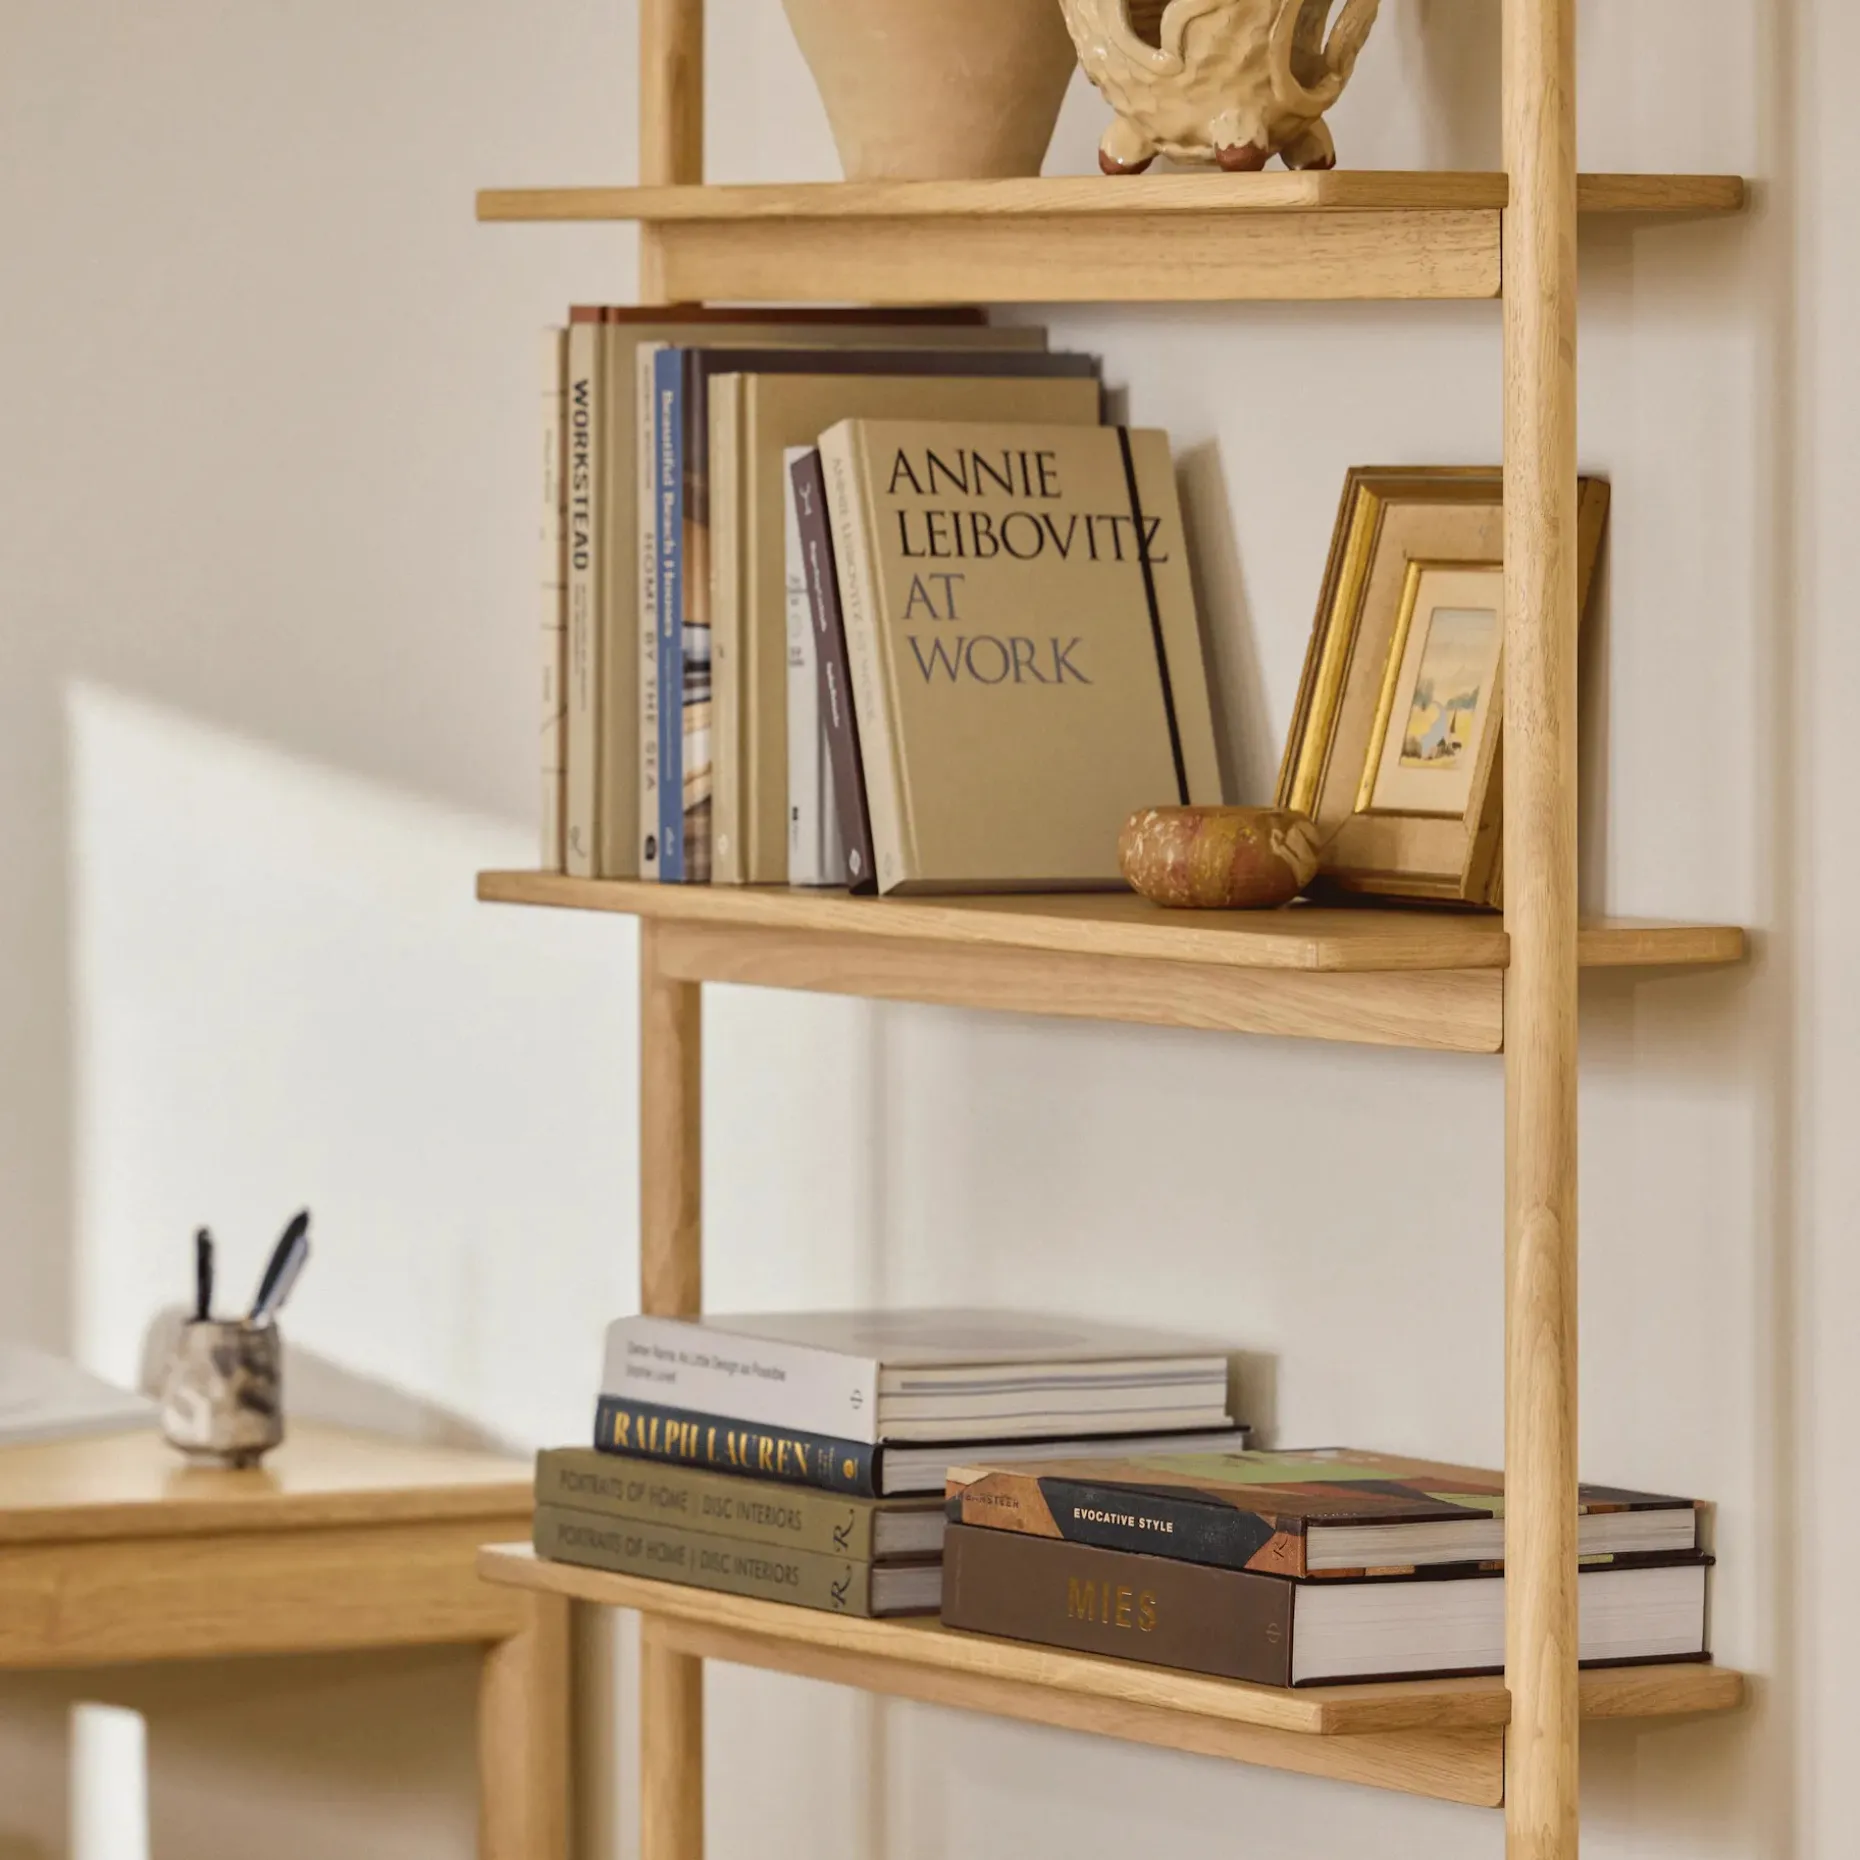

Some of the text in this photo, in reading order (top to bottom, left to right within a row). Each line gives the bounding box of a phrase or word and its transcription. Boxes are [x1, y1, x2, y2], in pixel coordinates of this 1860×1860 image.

[661, 389, 674, 487] Beautiful
[571, 378, 589, 572] WORKSTEAD
[886, 447, 1062, 499] ANNIE
[661, 491, 674, 555] Beach
[895, 509, 1169, 563] LEIBOVITZ
[902, 573, 966, 621] AT
[643, 532, 655, 793] HOME BY THE SEA
[907, 635, 1094, 685] WORK
[613, 1410, 698, 1459] RALPH
[707, 1427, 811, 1477] LAUREN
[560, 1469, 802, 1531] PORTRAITS OF HOME DISC INTERIORS
[1073, 1507, 1174, 1533] EVOCATIVE STYLE
[558, 1523, 799, 1586] PORTRAITS OF HOME DISC INTERIORS
[1068, 1576, 1156, 1632] MIES
